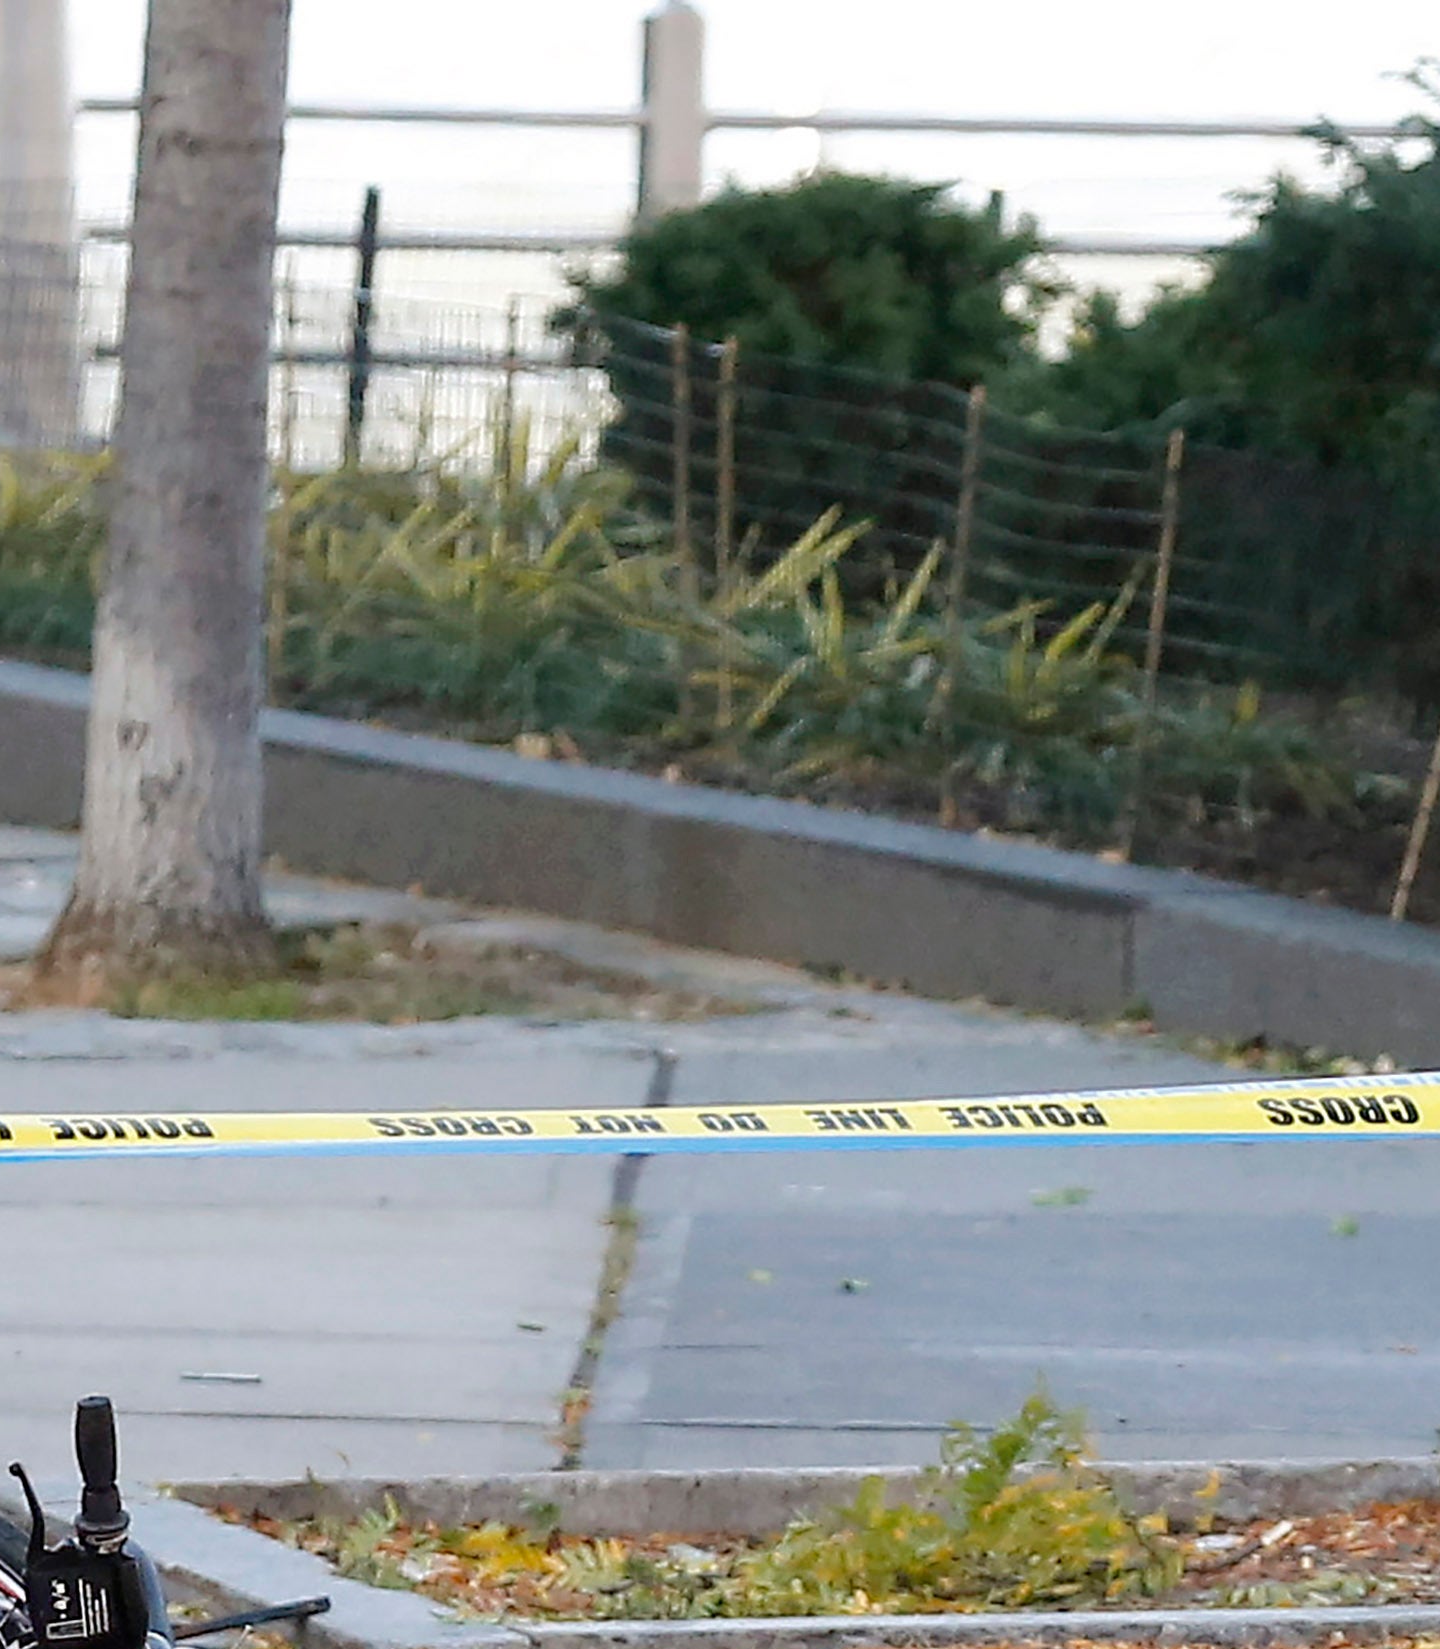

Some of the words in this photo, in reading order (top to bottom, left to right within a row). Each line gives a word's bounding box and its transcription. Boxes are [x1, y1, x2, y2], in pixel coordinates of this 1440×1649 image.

[696, 1112, 769, 1132] DO
[803, 1107, 912, 1131] LINE
[939, 1103, 1109, 1128] POLICE
[1258, 1095, 1421, 1126] CROSS
[368, 1116, 535, 1138] CROSS
[568, 1114, 667, 1135] NOT
